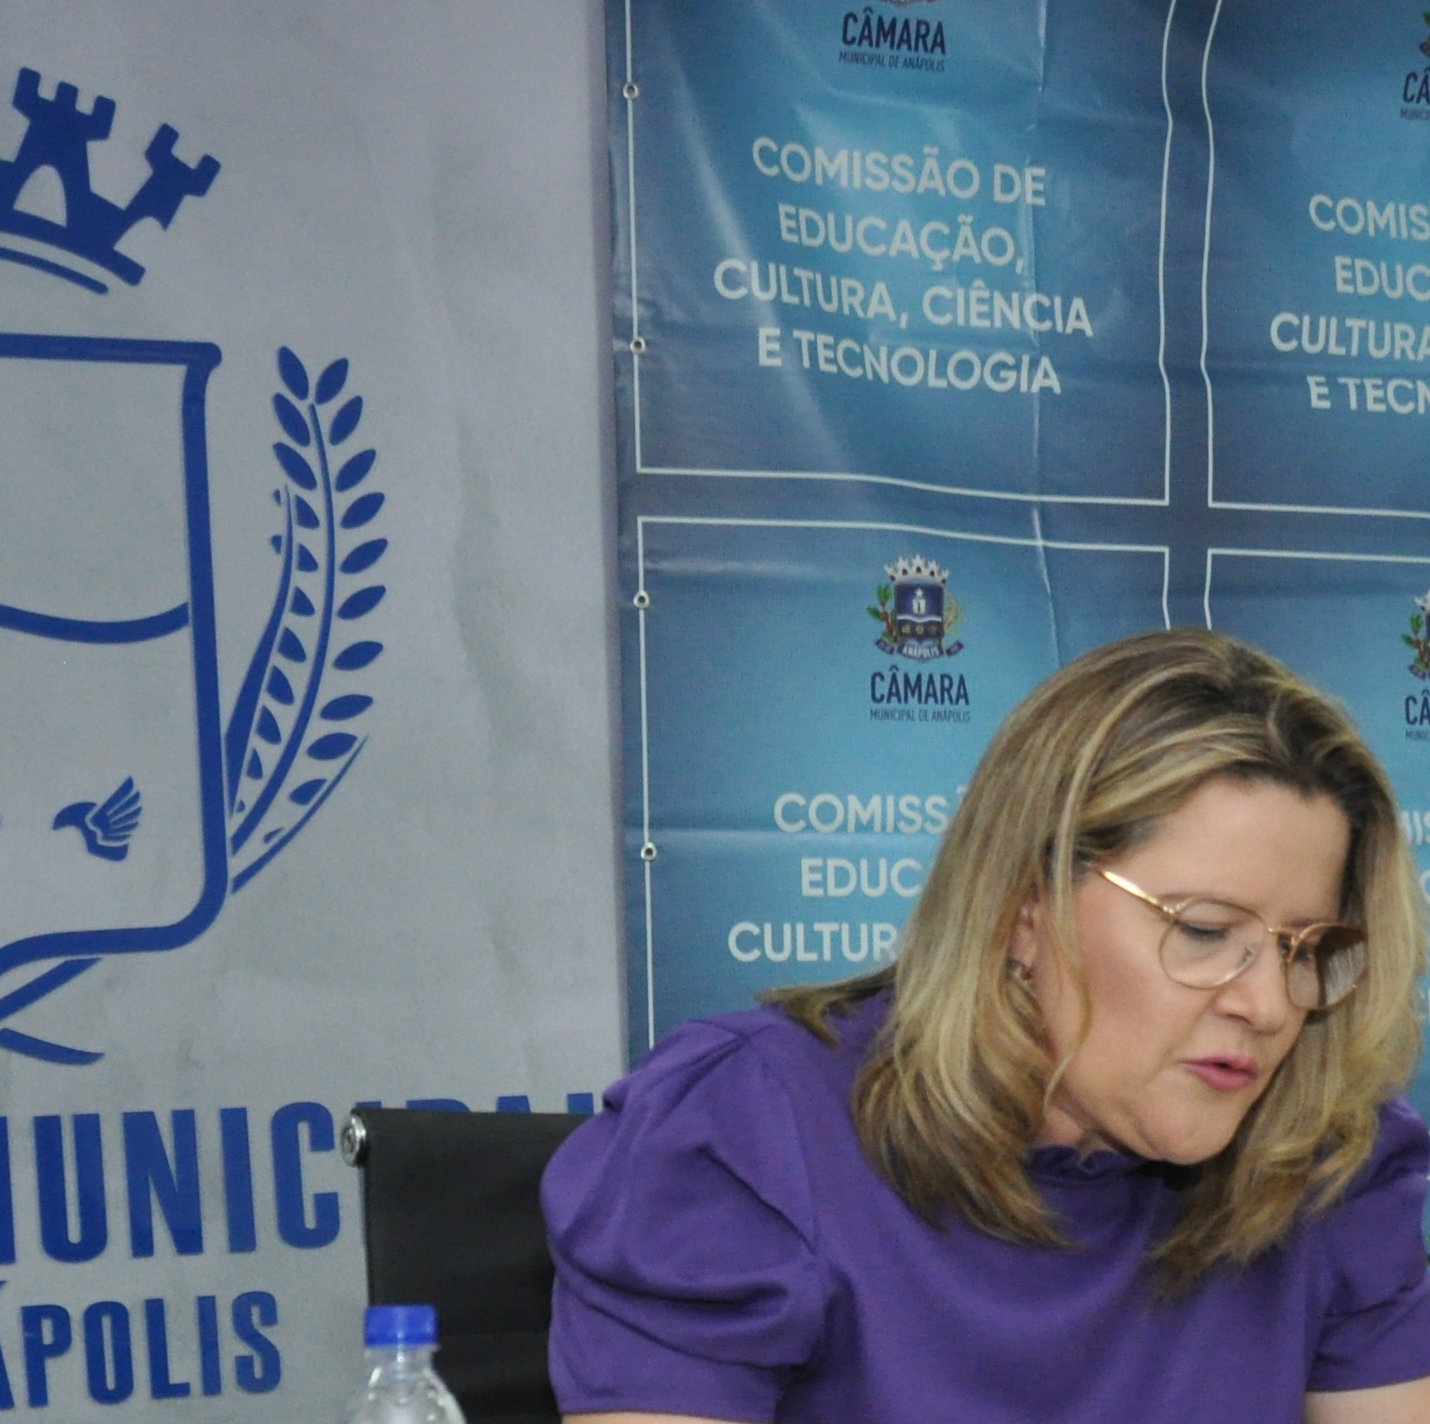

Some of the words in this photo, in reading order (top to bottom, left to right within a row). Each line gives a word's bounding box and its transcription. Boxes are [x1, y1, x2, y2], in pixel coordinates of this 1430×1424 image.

[841, 6, 946, 55] CÂMARA
[838, 51, 885, 67] MUNICIPAL
[888, 55, 899, 68] DE
[752, 136, 981, 200] COMISSÃO
[993, 163, 1046, 206] DE
[778, 202, 1024, 275] EDUCAÇÃO,
[713, 259, 909, 330] CULTURA,
[922, 279, 1094, 338] CIÊNCIA
[758, 326, 782, 368] E
[793, 329, 1062, 395] TECNOLOGIA
[1306, 375, 1331, 410] E
[870, 664, 970, 706] CÂMARA
[870, 708, 916, 721] MUNICIPAL
[919, 709, 929, 722] DE
[932, 708, 971, 723] ANÁPOLIS
[774, 786, 967, 834] COMISS
[728, 921, 899, 962] CULTUR
